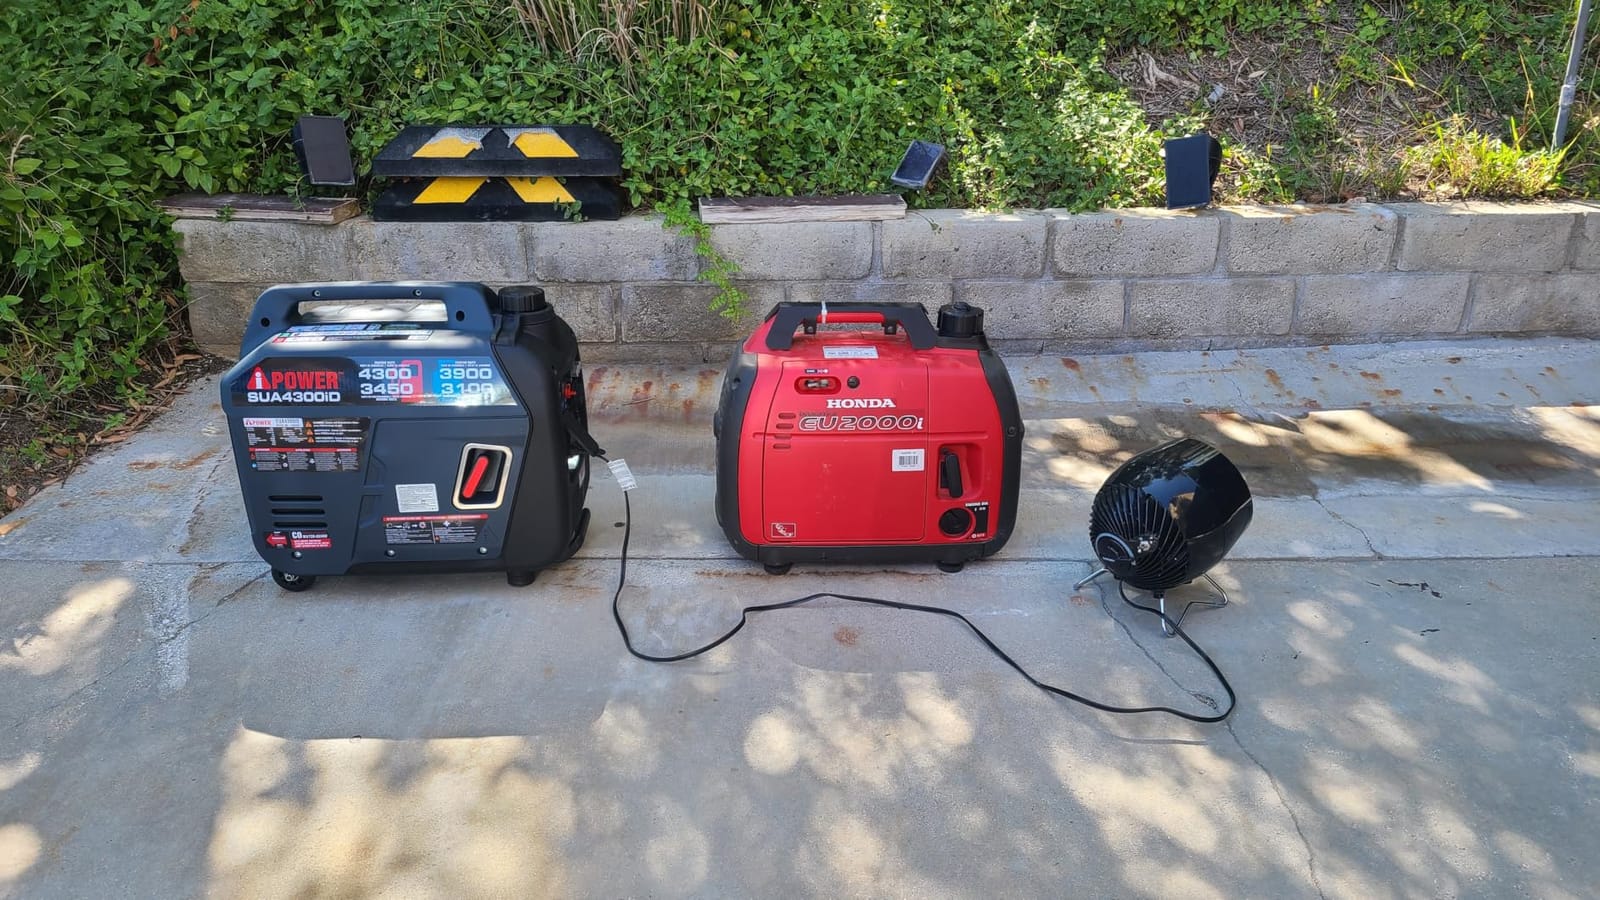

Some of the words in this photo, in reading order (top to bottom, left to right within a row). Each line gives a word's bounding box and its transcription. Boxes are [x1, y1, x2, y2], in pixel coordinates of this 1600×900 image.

[358, 368, 412, 380] 4300
[439, 368, 492, 380] 3900
[360, 383, 414, 395] 3450
[247, 391, 341, 402] SUA4300iD
[826, 398, 896, 409] HONDA
[799, 415, 923, 431] EU2000i
